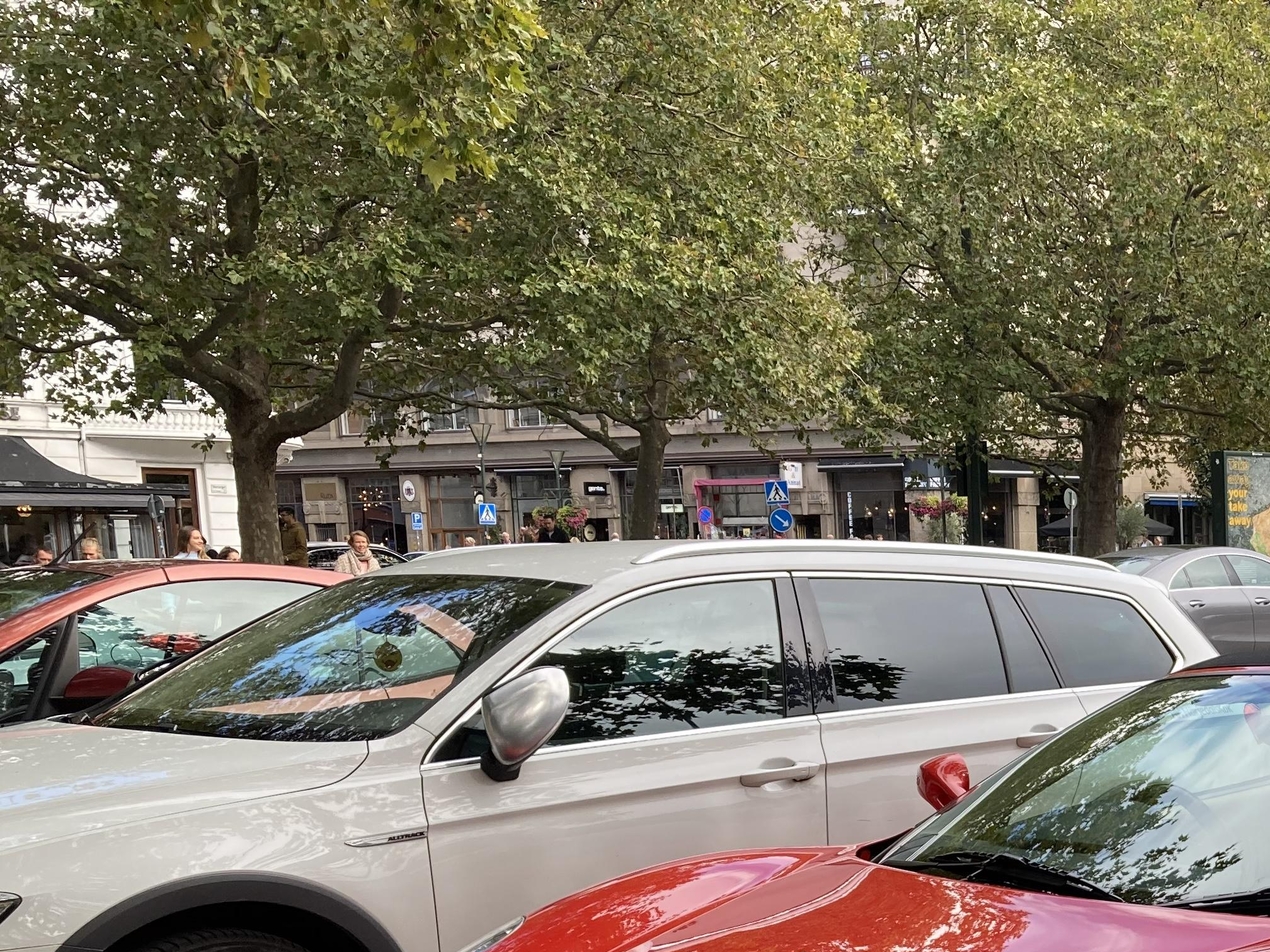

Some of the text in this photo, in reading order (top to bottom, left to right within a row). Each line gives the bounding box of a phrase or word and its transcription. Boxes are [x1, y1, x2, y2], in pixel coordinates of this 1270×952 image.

[1227, 489, 1247, 500] your
[1228, 501, 1248, 512] take
[1228, 516, 1251, 528] away
